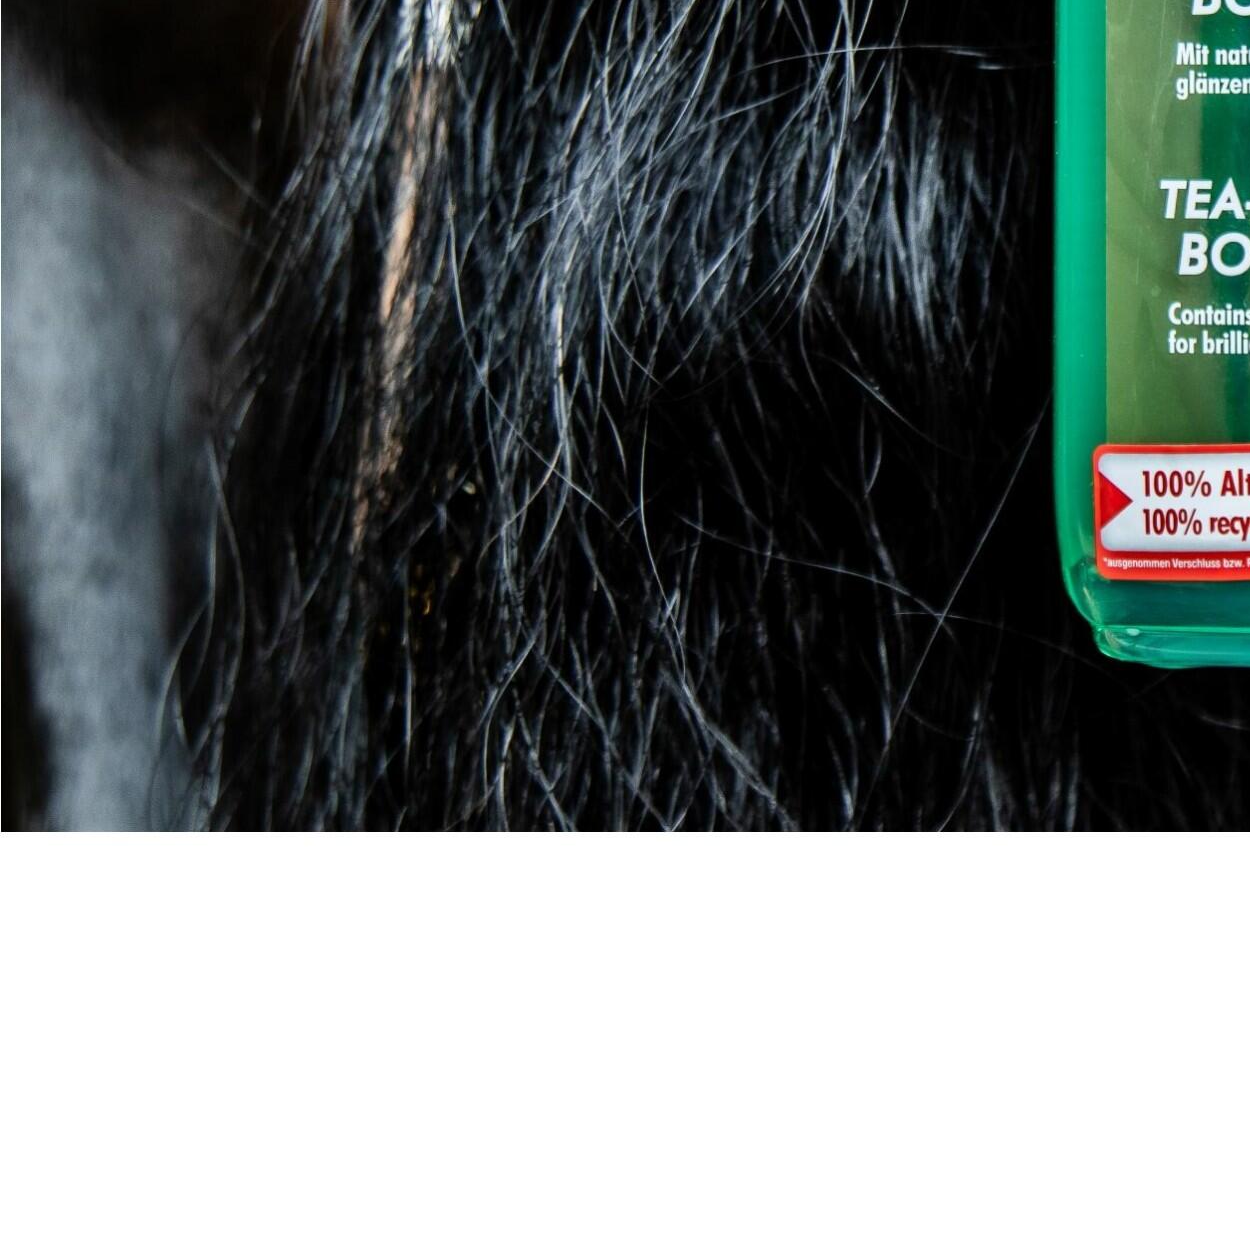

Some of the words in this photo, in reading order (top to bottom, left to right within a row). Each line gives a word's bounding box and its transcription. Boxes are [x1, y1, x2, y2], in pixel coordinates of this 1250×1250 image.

[1176, 42, 1209, 66] Mit
[1168, 330, 1197, 354] for
[1142, 470, 1212, 497] 100%
[1142, 508, 1202, 535] 100%
[1172, 557, 1220, 568] Verschluss
[1223, 557, 1245, 568] bzw.
